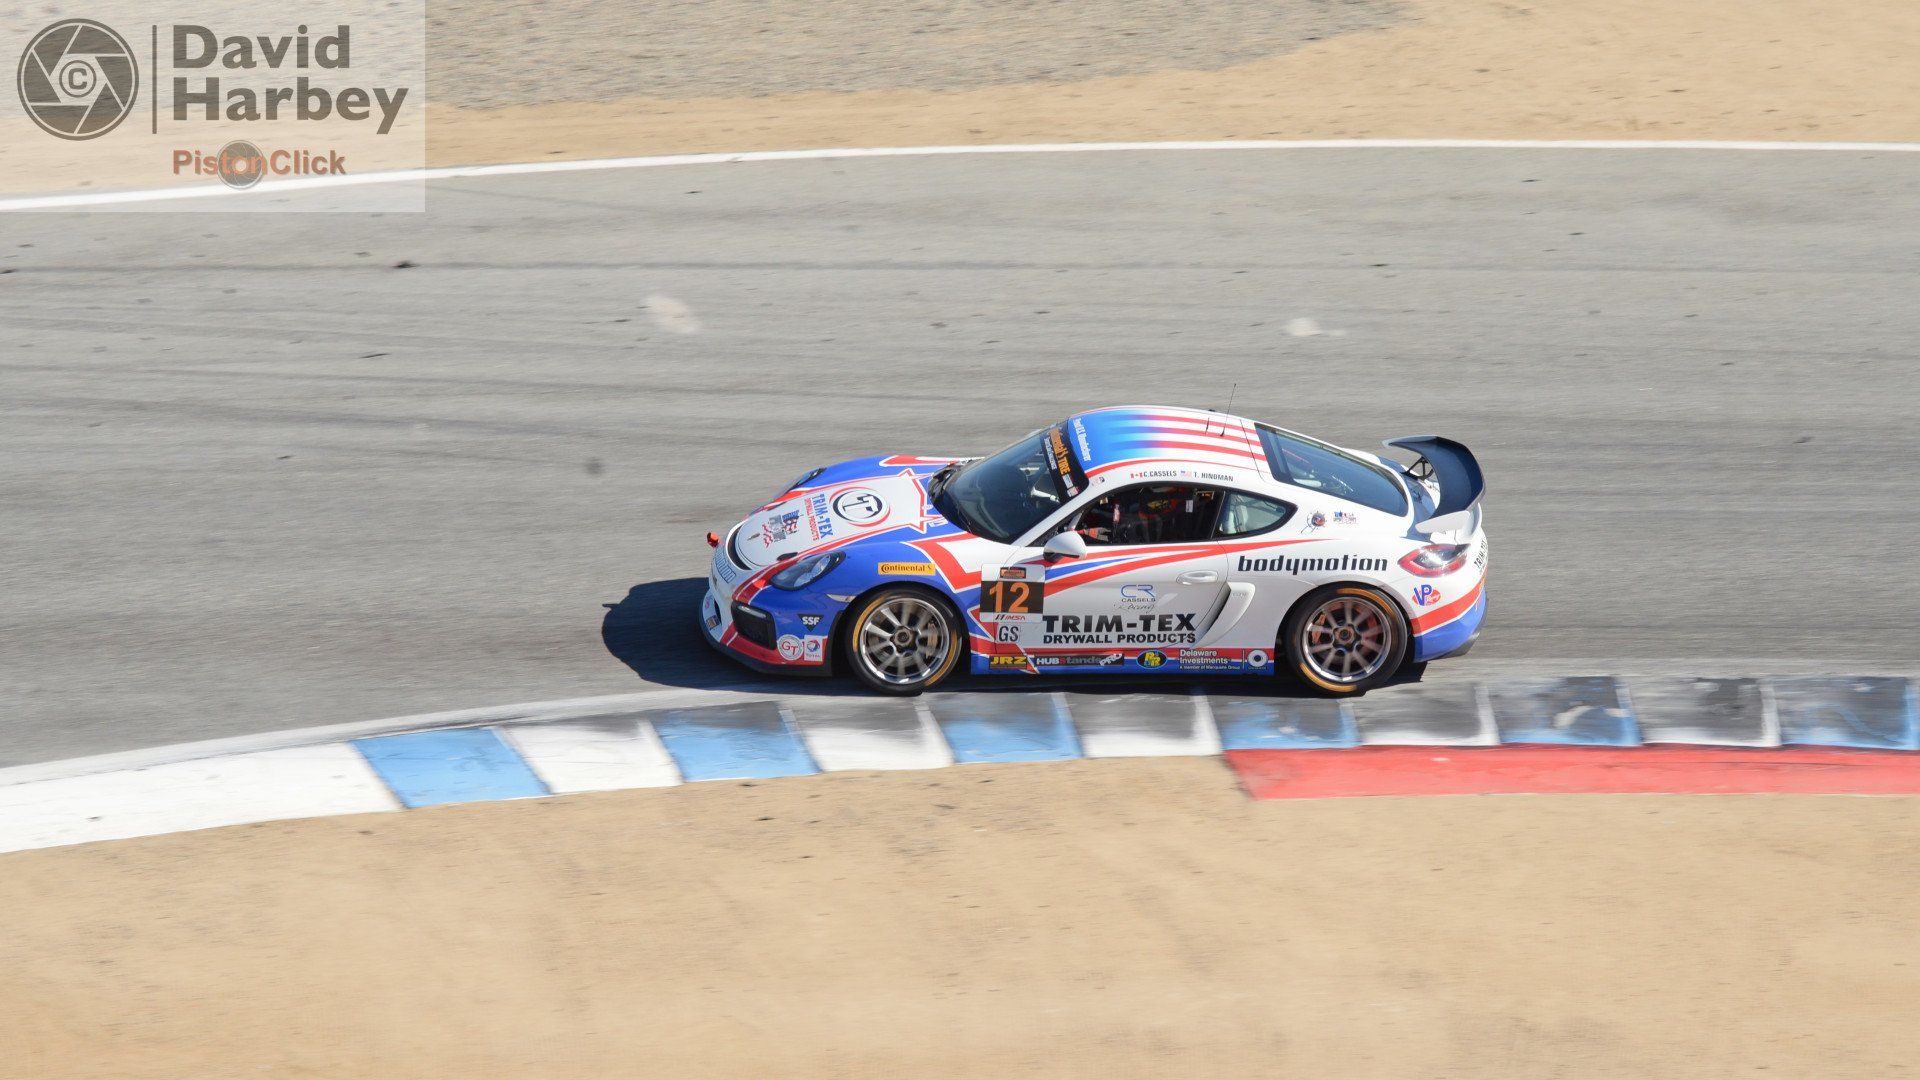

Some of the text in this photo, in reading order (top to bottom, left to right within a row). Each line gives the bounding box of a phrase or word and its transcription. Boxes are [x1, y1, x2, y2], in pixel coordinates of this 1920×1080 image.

[811, 493, 834, 539] TRIM-TEX
[881, 563, 926, 573] Continental
[1237, 554, 1388, 576] bodymotion
[989, 581, 1030, 613] 12
[1413, 584, 1433, 606] VP
[802, 616, 820, 625] SSF
[1042, 613, 1196, 633] TRIM-TEX
[998, 626, 1019, 642] GS
[1043, 633, 1196, 644] DRYWALL PRODUCTS
[781, 641, 798, 655] GT
[1180, 649, 1217, 657] Delaware
[991, 656, 1027, 665] JRZ
